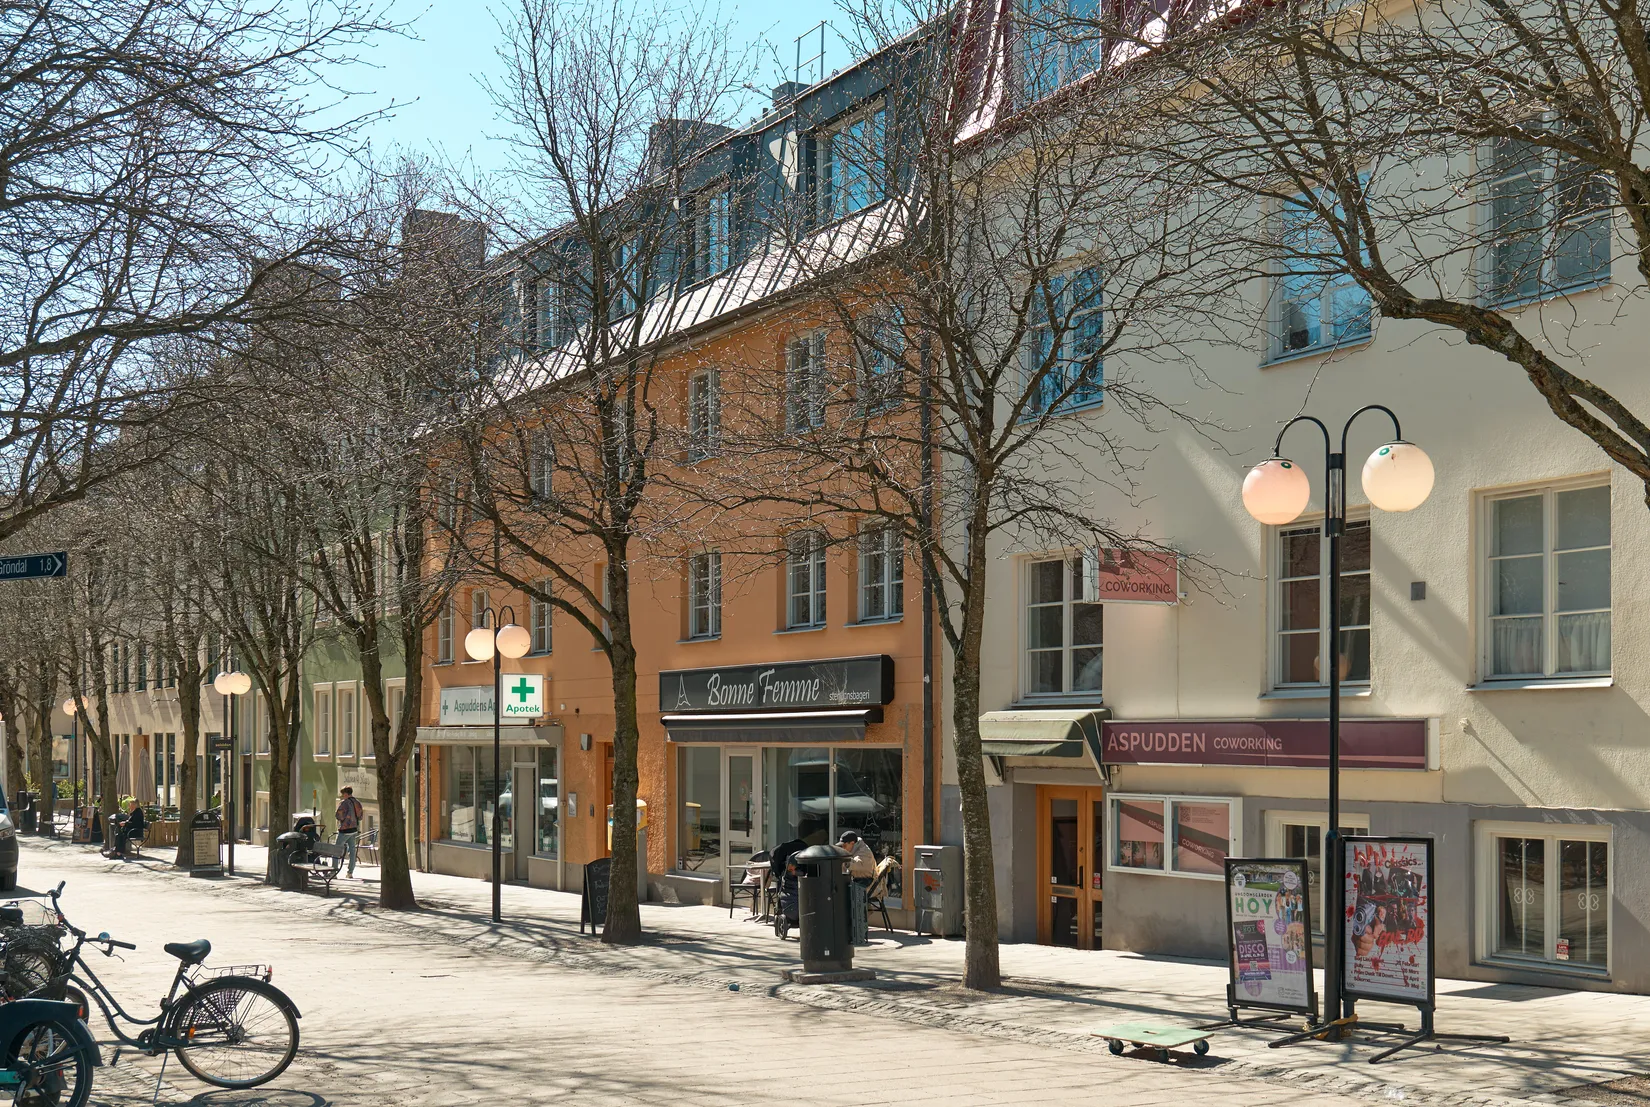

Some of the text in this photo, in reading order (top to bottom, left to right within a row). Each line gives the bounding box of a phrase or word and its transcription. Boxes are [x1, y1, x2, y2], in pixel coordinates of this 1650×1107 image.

[0, 558, 52, 575] Gröndal 1,8
[1105, 581, 1171, 594] COWORKING
[707, 668, 820, 706] Bonne Femme
[454, 698, 487, 716] Aspuddens
[506, 704, 540, 714] Apotek
[1107, 732, 1283, 753] ASPUDDEN COWORKING
[1181, 838, 1215, 859] COWORKING
[1235, 897, 1272, 915] HOY
[1239, 943, 1265, 954] DISCO
